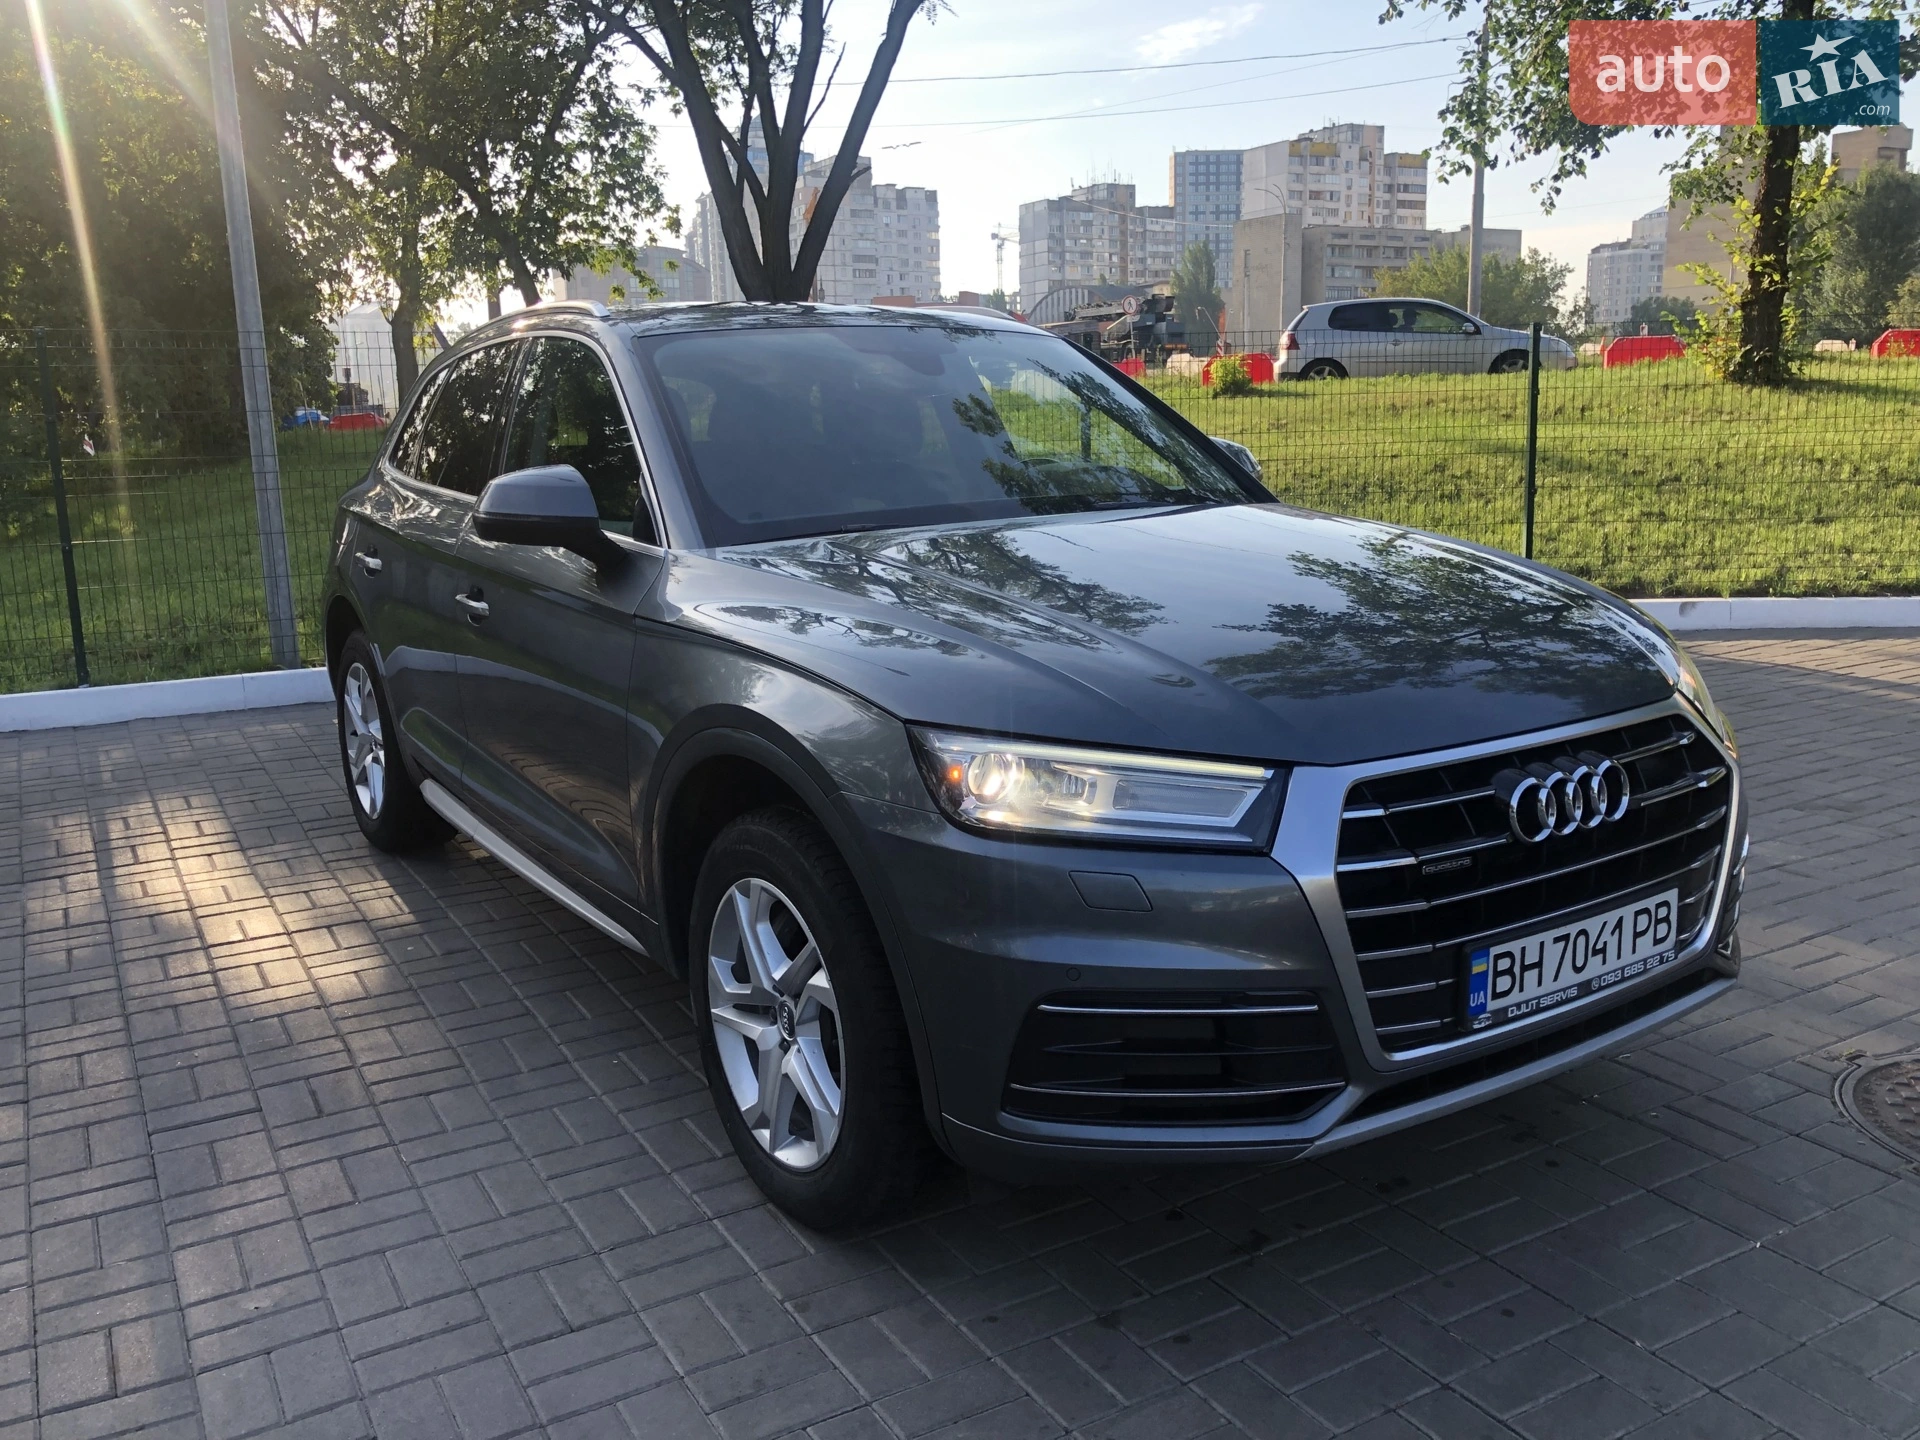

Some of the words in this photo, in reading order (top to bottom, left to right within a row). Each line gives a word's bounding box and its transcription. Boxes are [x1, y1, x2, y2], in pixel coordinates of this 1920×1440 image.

[1490, 941, 1544, 1001] BH
[1552, 914, 1623, 983] 7041
[1632, 899, 1673, 955] PB
[1601, 970, 1622, 986] 093
[1624, 962, 1644, 977] 685
[1646, 956, 1660, 968] 22
[1662, 950, 1675, 963] 75
[1470, 993, 1485, 1007] UA
[1508, 1000, 1538, 1017] DJUT
[1540, 987, 1577, 1007] SERVIS
